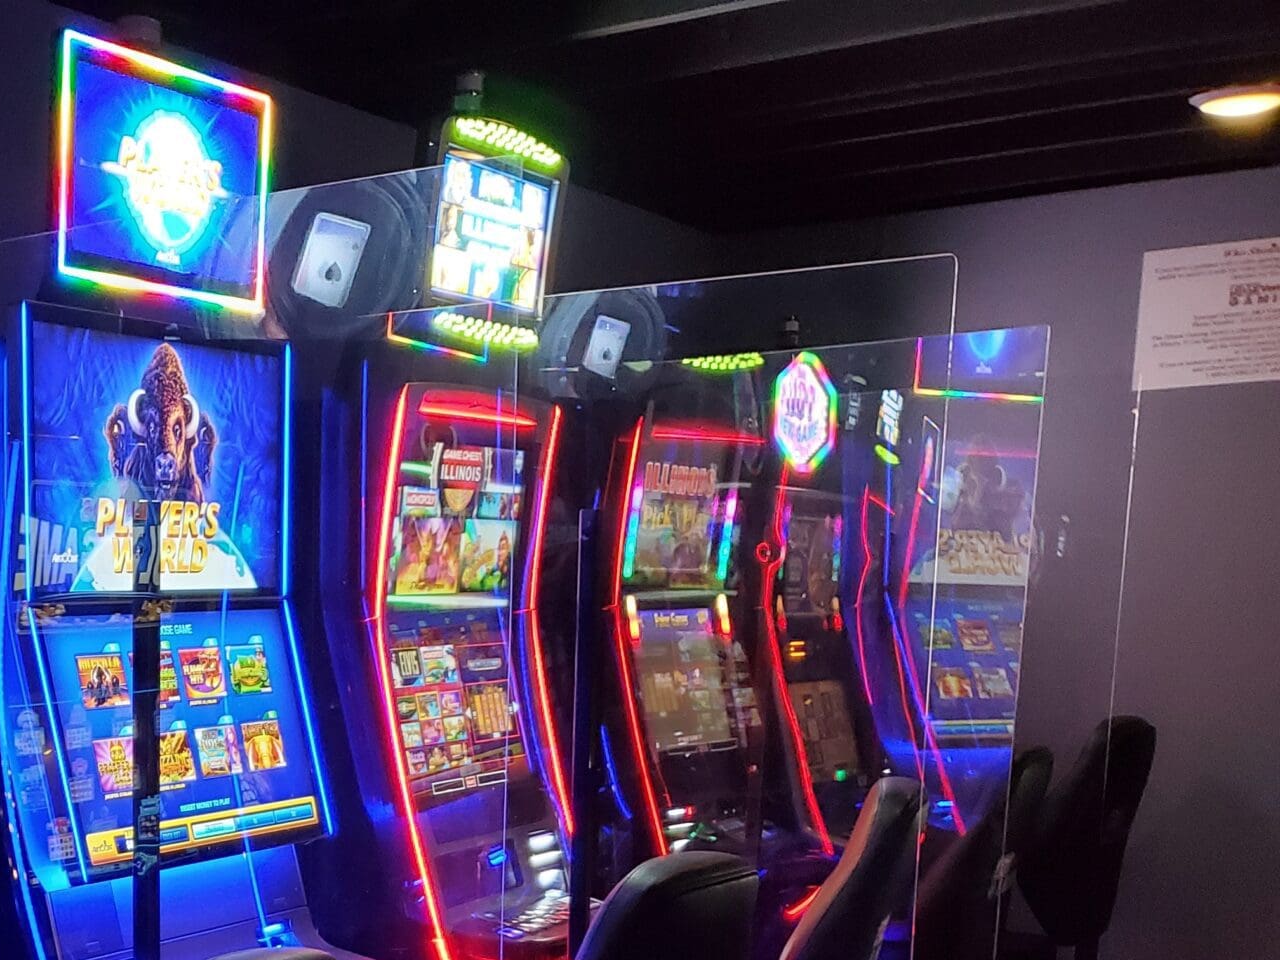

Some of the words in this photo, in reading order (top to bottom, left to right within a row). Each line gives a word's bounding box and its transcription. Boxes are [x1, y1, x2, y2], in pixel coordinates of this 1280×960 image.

[440, 464, 481, 482] ILLINOIS
[644, 461, 716, 498] ILLINOIS
[95, 497, 221, 538] PLYER'S
[112, 538, 209, 574] WRLD
